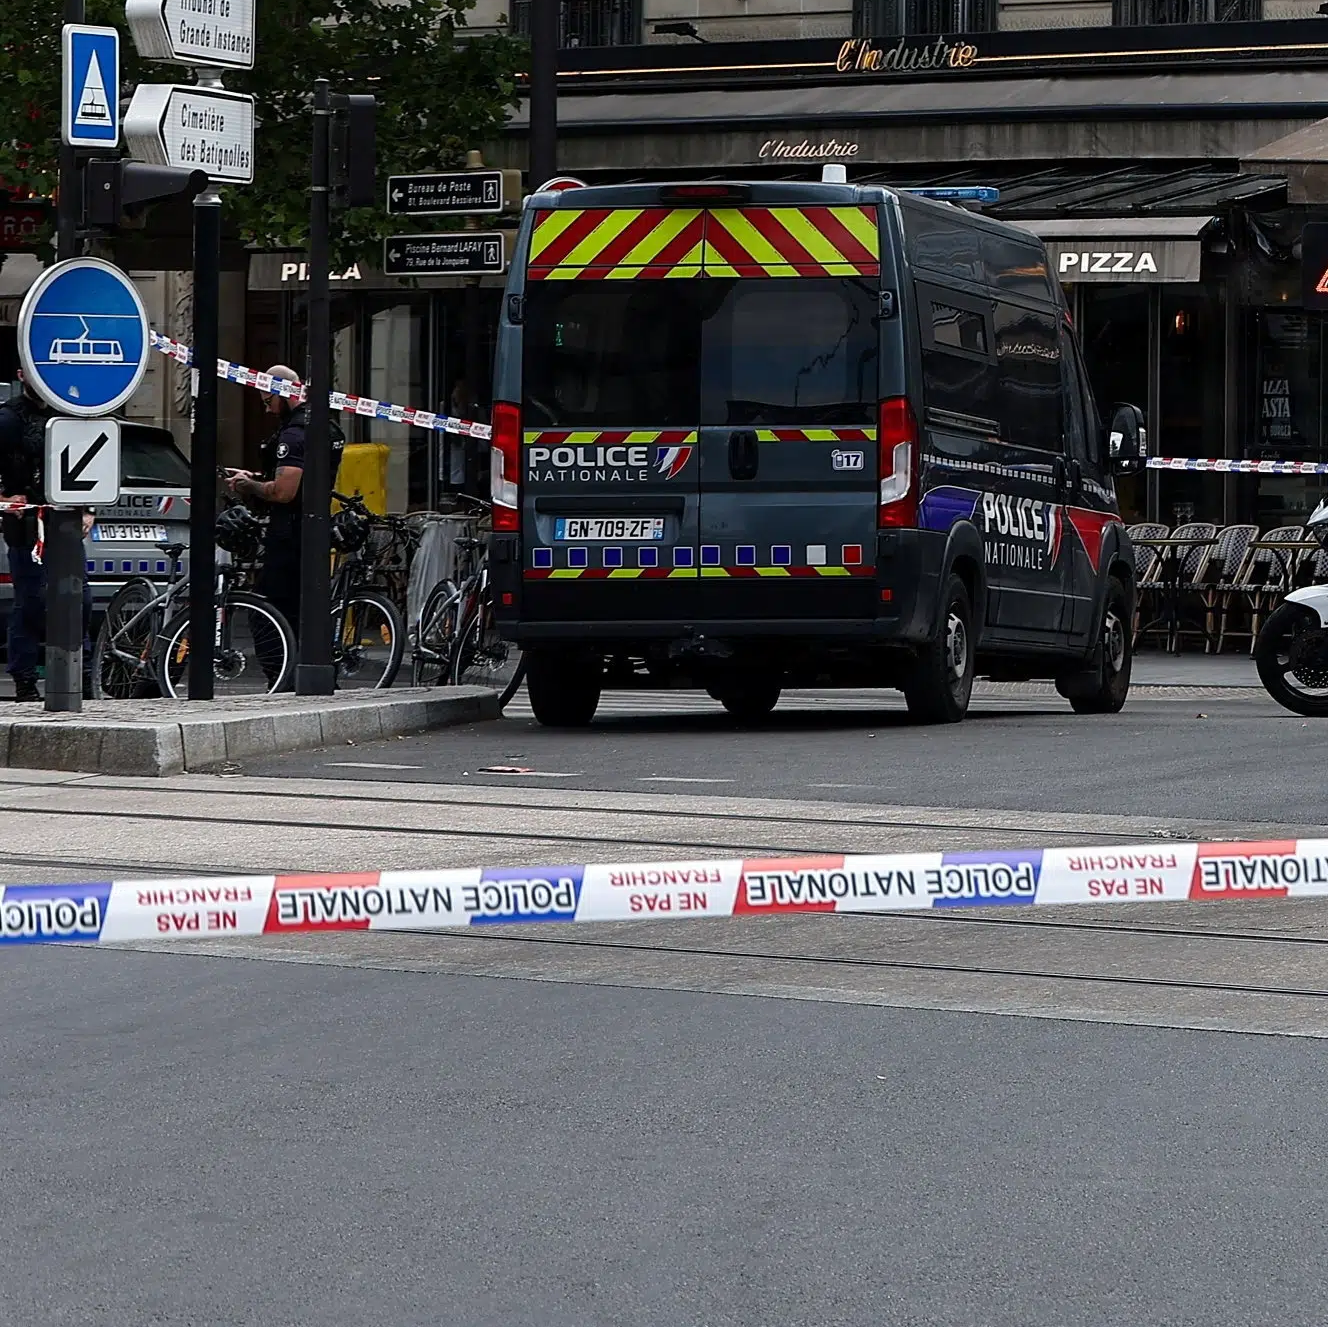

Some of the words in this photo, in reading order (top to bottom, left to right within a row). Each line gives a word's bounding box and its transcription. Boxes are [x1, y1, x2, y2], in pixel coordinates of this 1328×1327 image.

[179, 19, 211, 47] Grande
[214, 25, 250, 54] Instance
[181, 103, 225, 132] Cimetière
[180, 136, 196, 161] des
[200, 138, 250, 172] Batignolles
[757, 140, 860, 158] l'Industrie
[407, 183, 435, 194] Bureau
[437, 181, 447, 192] de
[449, 181, 472, 192] Poste
[419, 196, 450, 206] Boulevard
[405, 243, 430, 254] Piscine
[431, 242, 458, 253] Bernard
[458, 241, 483, 252] LAFAY
[281, 262, 362, 281] PIA
[1059, 251, 1158, 274] PIZZA
[1261, 398, 1291, 419] ASTA
[528, 446, 649, 468] POLICE
[843, 454, 861, 467] 17
[528, 470, 649, 482] NATIONALE
[105, 495, 154, 508] LICE
[97, 509, 152, 517] ATIONALE
[982, 492, 1046, 542] POLICE
[568, 520, 650, 538] GN-709-ZF
[653, 529, 663, 538] 75
[984, 541, 1043, 571] NATIONALE
[1068, 852, 1178, 870] FRANCHIR
[609, 867, 722, 887] FRANCHIR
[747, 870, 917, 904] NATIONALE
[926, 864, 1033, 896] POLICE
[1088, 878, 1129, 897] PAS
[1136, 876, 1164, 896] NE
[137, 886, 253, 907] FRANCHIR
[279, 888, 451, 921] NATIONALE
[463, 879, 573, 914] POLICE
[631, 892, 673, 913] PAS
[679, 891, 707, 910] NE
[2, 897, 99, 936] POLIC
[156, 911, 202, 932] PAS
[208, 910, 237, 931] NE
